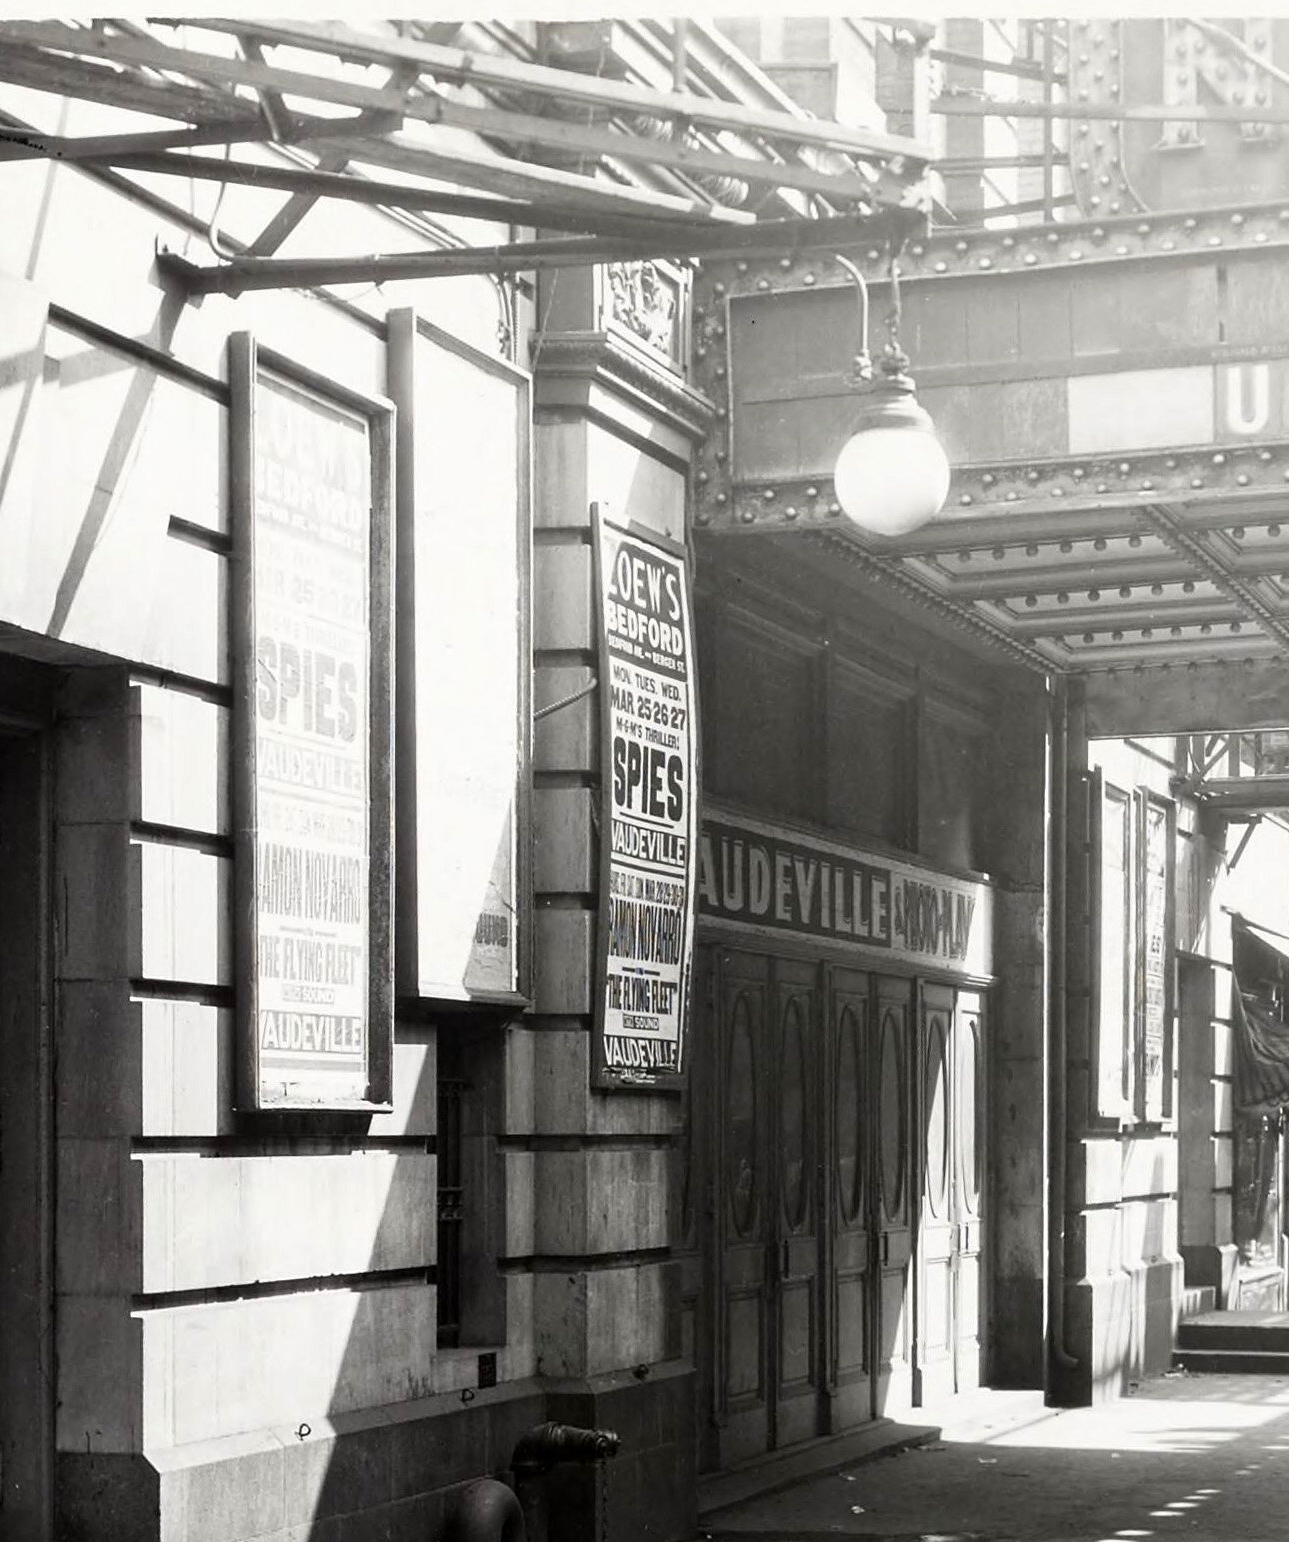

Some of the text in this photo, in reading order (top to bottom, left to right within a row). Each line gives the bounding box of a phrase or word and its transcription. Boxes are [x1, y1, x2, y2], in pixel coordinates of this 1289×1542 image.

[607, 599, 685, 656] BEDFORD
[258, 635, 358, 743] SPIES
[613, 736, 684, 822] SPIES
[611, 819, 685, 866] VAUDEVILLE
[259, 842, 302, 917] AMON
[261, 1010, 362, 1054] VAUDEVILLE
[603, 1035, 677, 1068] VAUDEVILLE
